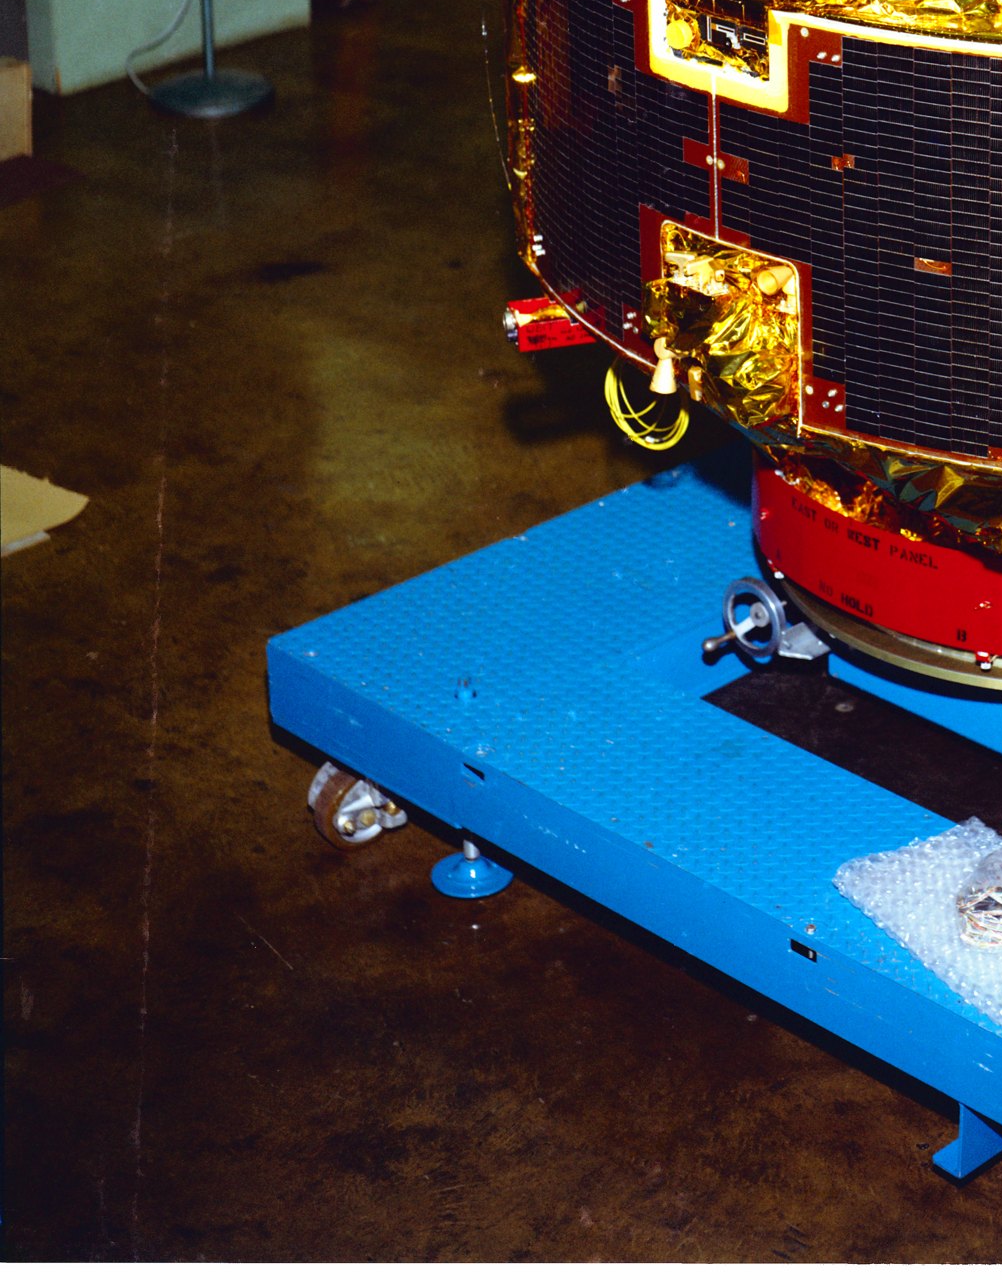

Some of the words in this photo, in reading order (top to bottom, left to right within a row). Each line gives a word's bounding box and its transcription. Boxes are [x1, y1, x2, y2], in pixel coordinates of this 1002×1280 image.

[791, 495, 817, 521] EAST
[824, 517, 839, 535] OR
[847, 528, 880, 551] WEST
[889, 544, 939, 570] PANEL
[818, 580, 833, 597] NO
[841, 592, 874, 618] HOLD
